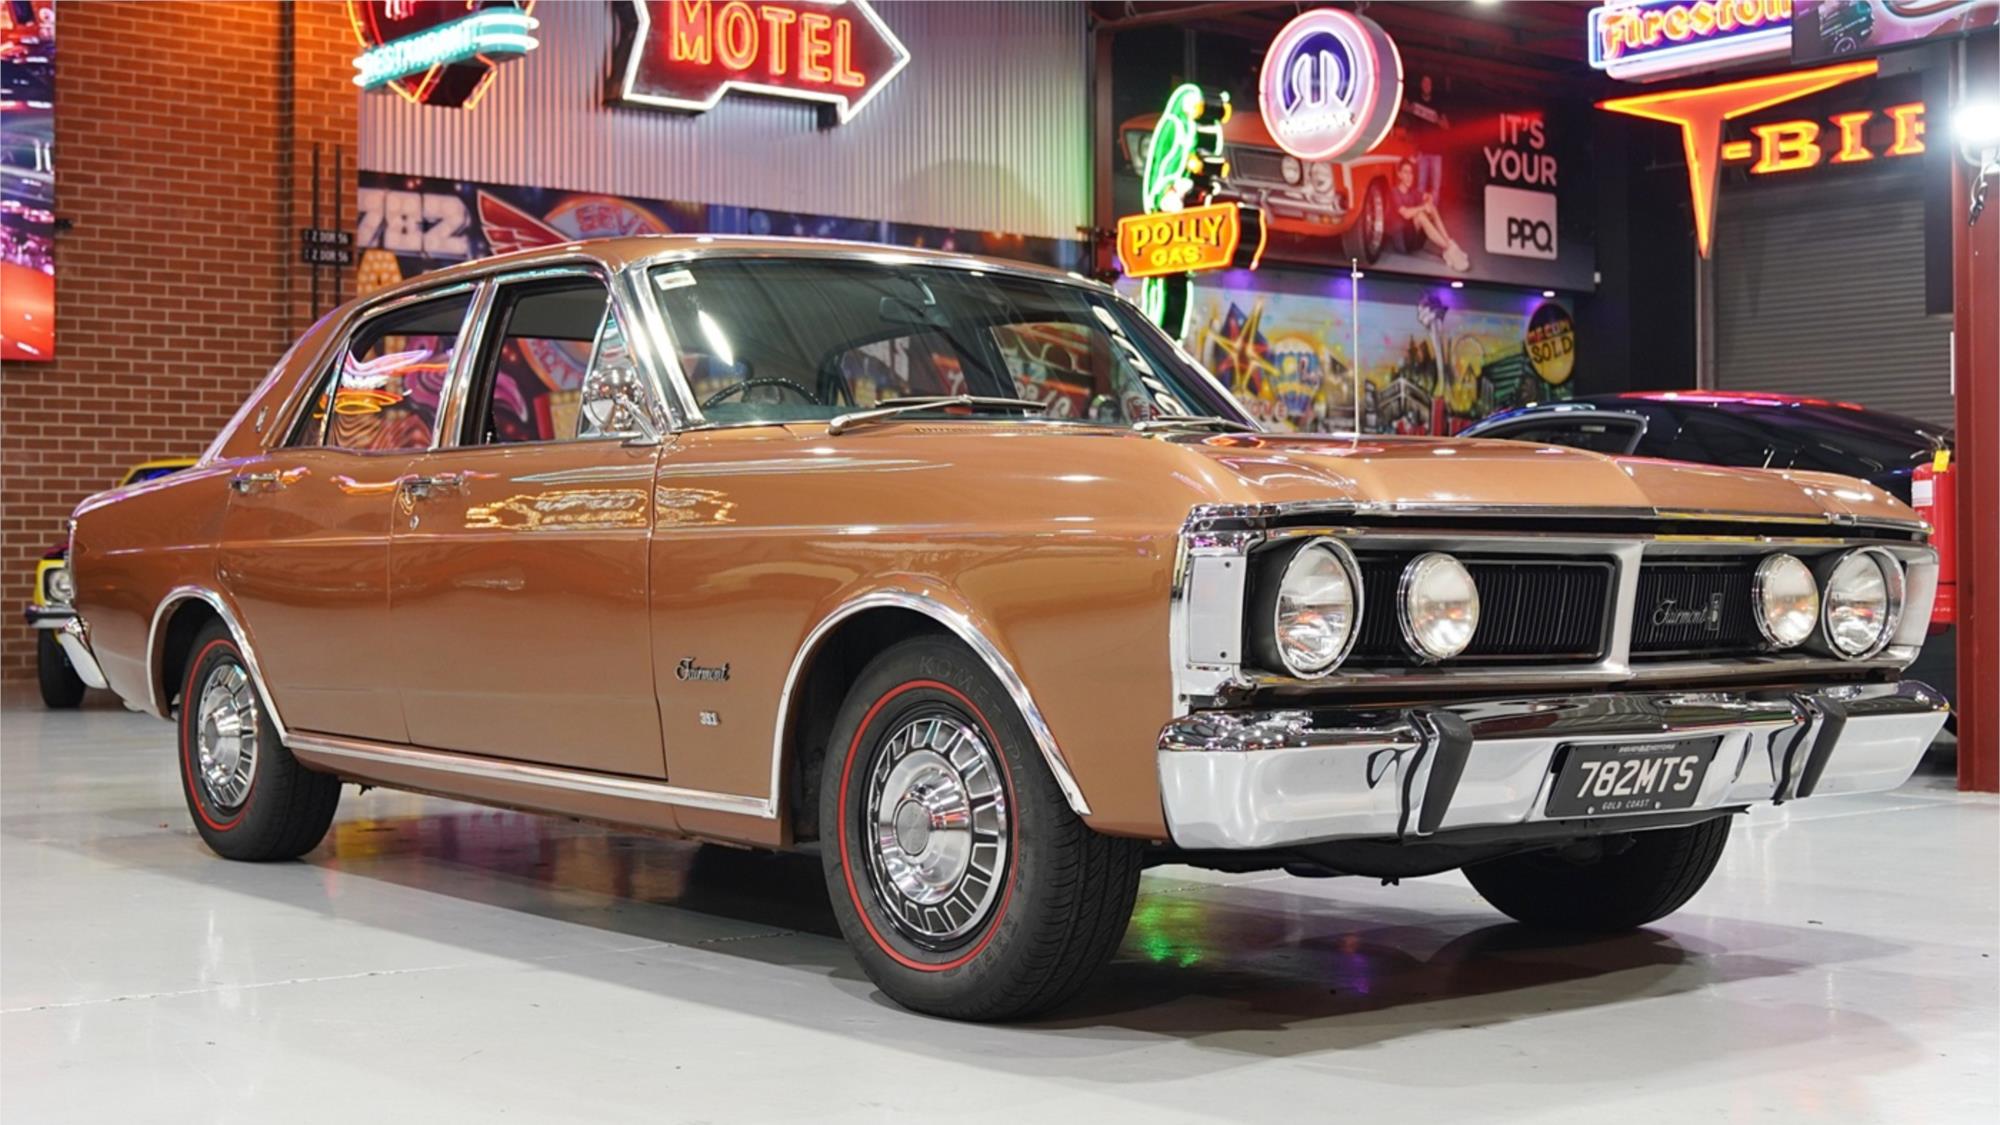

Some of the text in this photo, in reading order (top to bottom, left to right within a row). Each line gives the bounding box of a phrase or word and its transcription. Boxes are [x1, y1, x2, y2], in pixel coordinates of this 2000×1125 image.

[669, 0, 865, 87] MOTEL
[1598, 0, 1792, 59] Fireston
[1500, 113, 1546, 150] IT'S
[1484, 146, 1557, 187] YOUR
[357, 187, 471, 257] 782
[1130, 214, 1225, 256] POLLY
[1507, 216, 1554, 253] PPQ
[1151, 245, 1201, 267] GAS
[1531, 336, 1573, 364] SOLD
[1577, 755, 1699, 799] 782MTS
[1602, 798, 1651, 811] GOLD COAST
